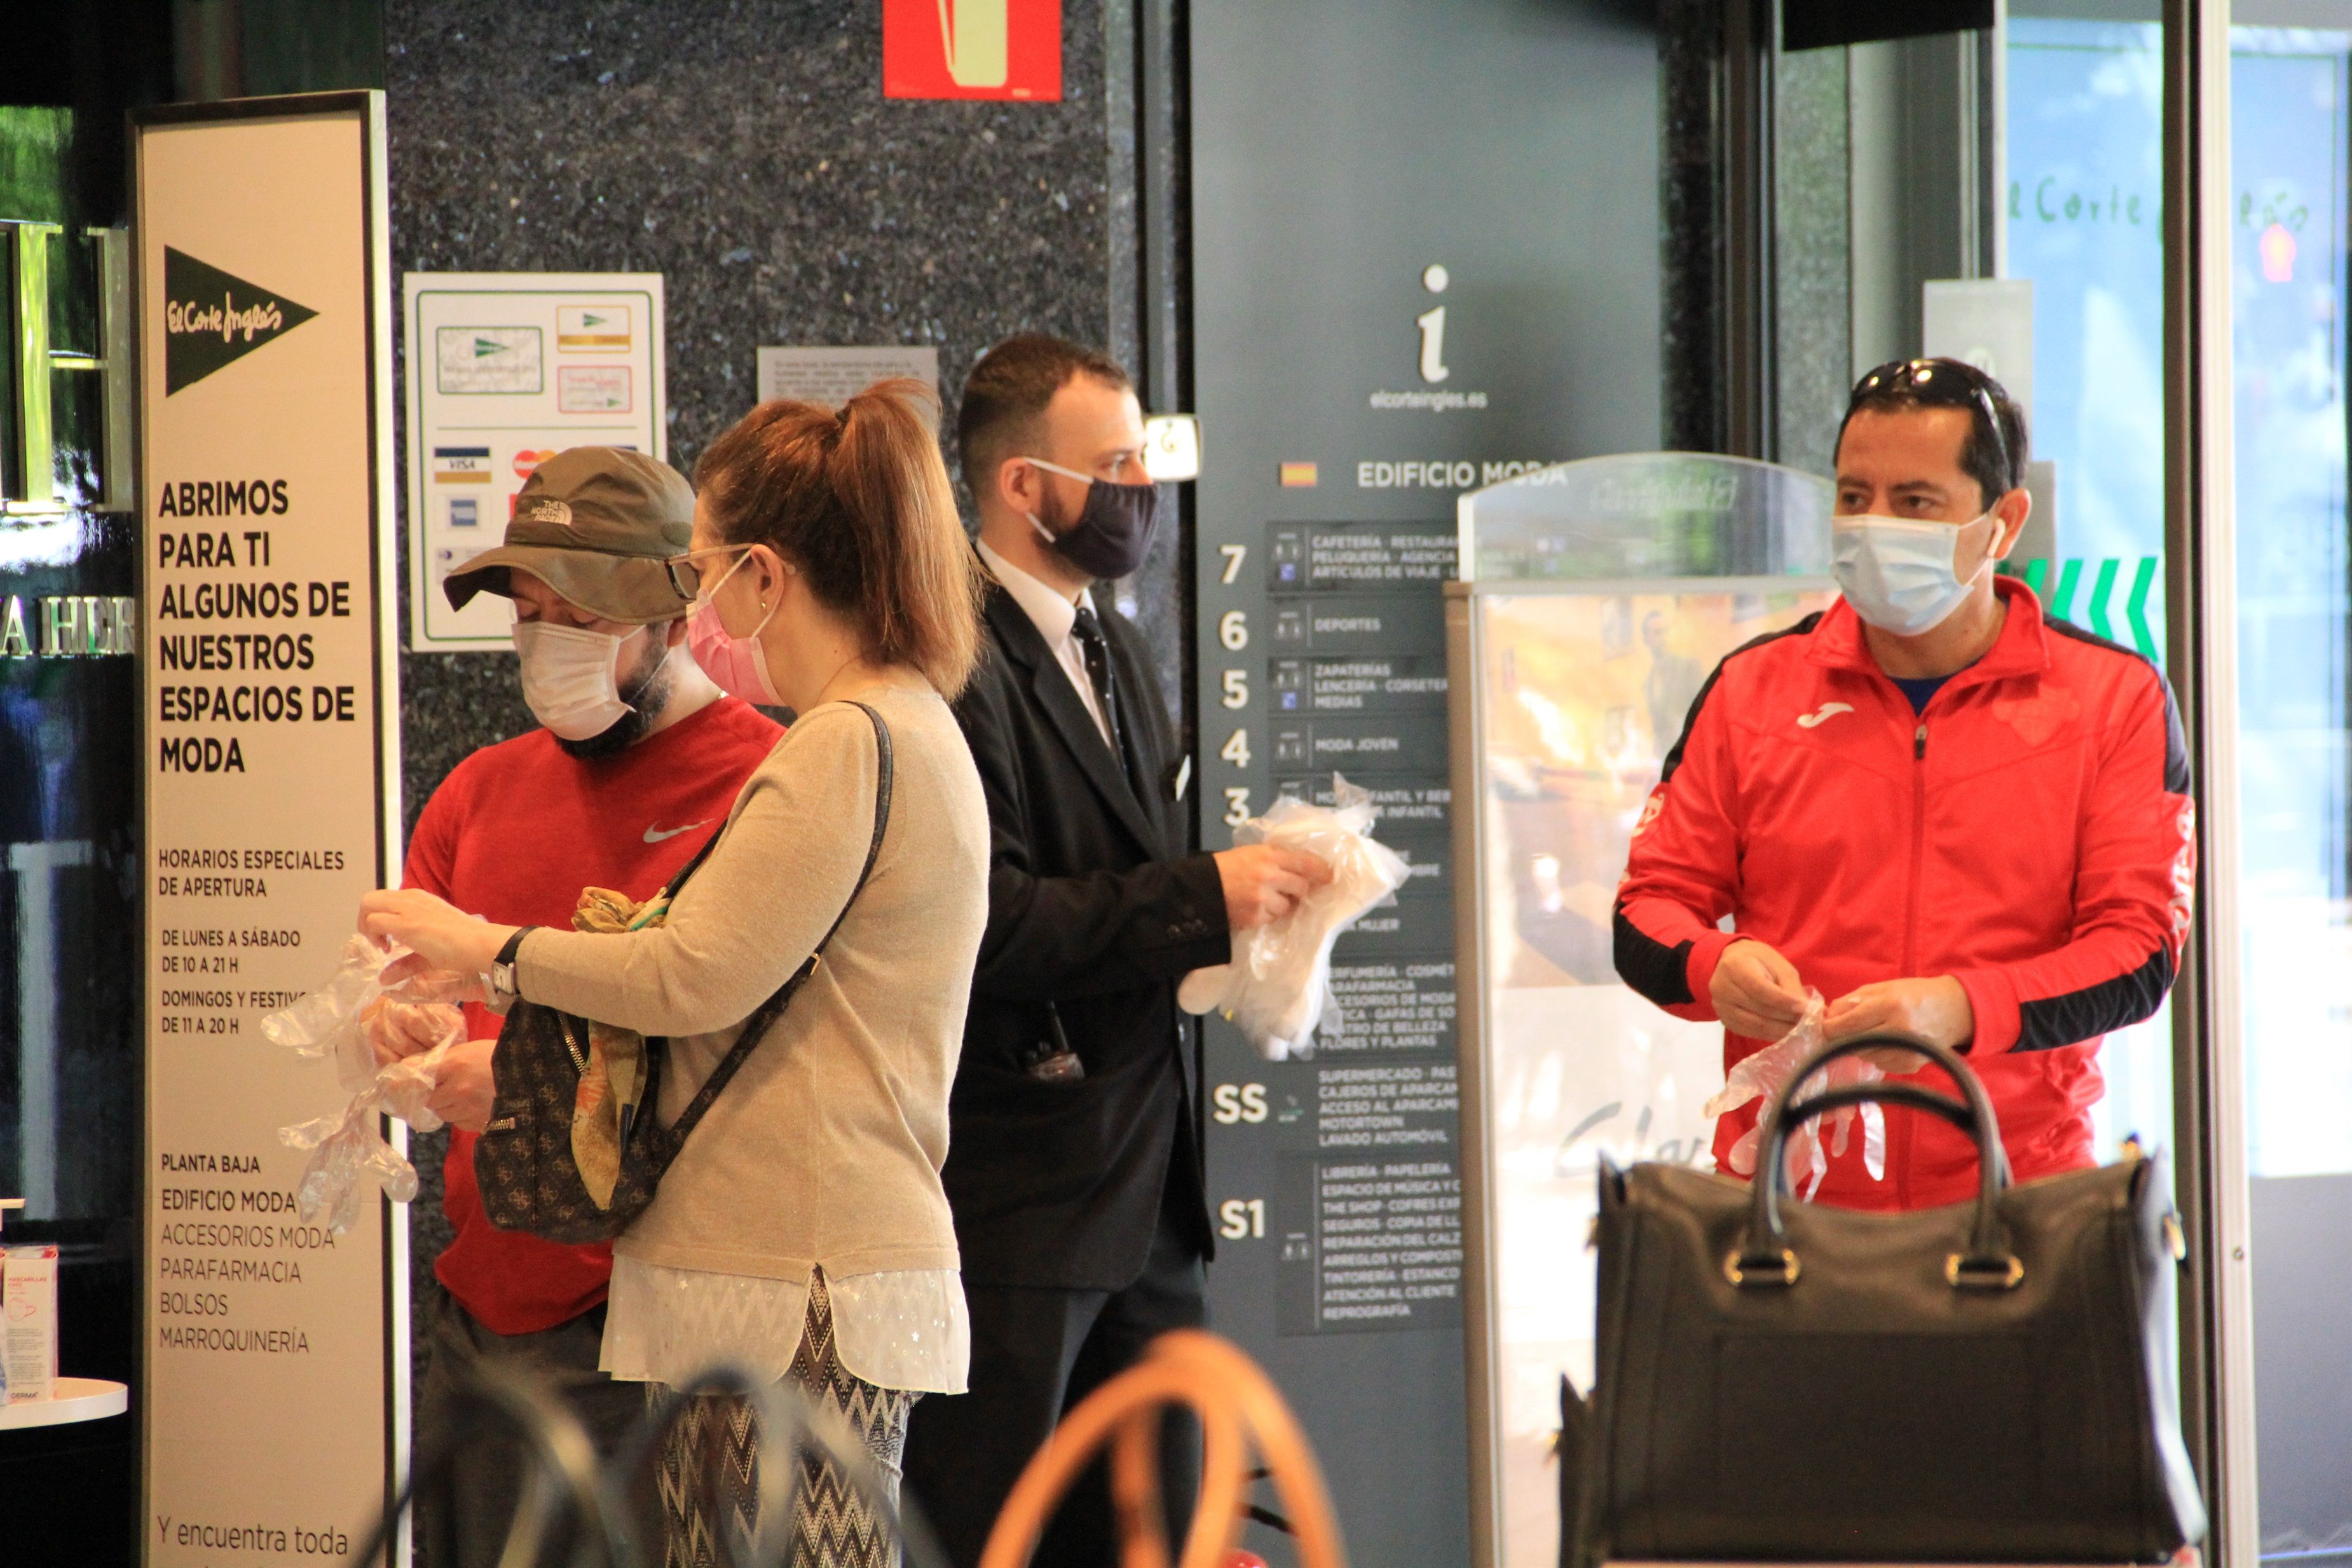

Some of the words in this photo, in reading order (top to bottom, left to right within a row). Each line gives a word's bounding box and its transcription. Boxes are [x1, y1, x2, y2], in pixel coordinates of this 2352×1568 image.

[168, 300, 184, 334] El
[184, 301, 223, 332] Corte
[222, 291, 284, 343] Inglés
[1369, 390, 1488, 412] elcorteingles.es
[449, 458, 477, 470] VISA
[1357, 461, 1475, 488] EDIFICIO
[1482, 461, 1569, 488] MODA
[158, 479, 289, 517] ABRIMOS
[531, 507, 559, 516] NORTH
[543, 500, 559, 509] THE
[158, 533, 235, 568] PARA
[243, 531, 270, 566] TI
[1220, 544, 1247, 585] 7
[158, 582, 299, 619] ALGUNOS
[308, 582, 350, 617] DE
[1220, 610, 1248, 651] 6
[160, 634, 314, 671] NUESTROS
[1222, 670, 1249, 710] 5
[160, 686, 303, 722] ESPACIOS
[312, 686, 355, 721] DE
[160, 737, 245, 773] MODA
[1220, 729, 1251, 768] 4
[1315, 738, 1353, 753] MODA
[1356, 737, 1399, 752] JOVEN
[1224, 787, 1250, 826] 3
[158, 849, 238, 869] HORARIOS
[244, 850, 345, 870] ESPECIALES
[158, 877, 178, 896] DE
[182, 878, 267, 897] APERTURA
[162, 930, 178, 946] DE
[182, 930, 223, 947] LUNES
[228, 930, 238, 947] A
[242, 925, 301, 947] SÁBADO
[161, 956, 179, 972] DE
[182, 957, 196, 972] 10
[200, 957, 209, 972] A
[213, 957, 225, 972] 21
[229, 957, 238, 973] H
[161, 990, 232, 1007] DOMINGOS
[236, 992, 247, 1007] Y
[250, 992, 306, 1008] FESTIV
[161, 1017, 179, 1033] DE
[182, 1018, 192, 1033] 11
[196, 1018, 205, 1034] A
[209, 1018, 225, 1034] 20
[229, 1018, 239, 1034] H
[1213, 1082, 1268, 1125] SS
[161, 1154, 217, 1173] PLANTA
[221, 1156, 261, 1174] BAJA
[161, 1189, 235, 1212] EDIFICIO
[240, 1191, 296, 1213] MODA
[1219, 1198, 1266, 1240] S1
[161, 1223, 273, 1248] ACCESORIOS
[280, 1226, 336, 1250] MODA
[160, 1257, 302, 1283] PARAFARMACIA
[160, 1292, 228, 1316] BOLSOS
[160, 1326, 310, 1354] MARROQUINERÍA
[157, 1515, 171, 1544] Y
[177, 1523, 286, 1552] encuentra
[295, 1526, 348, 1555] toda
